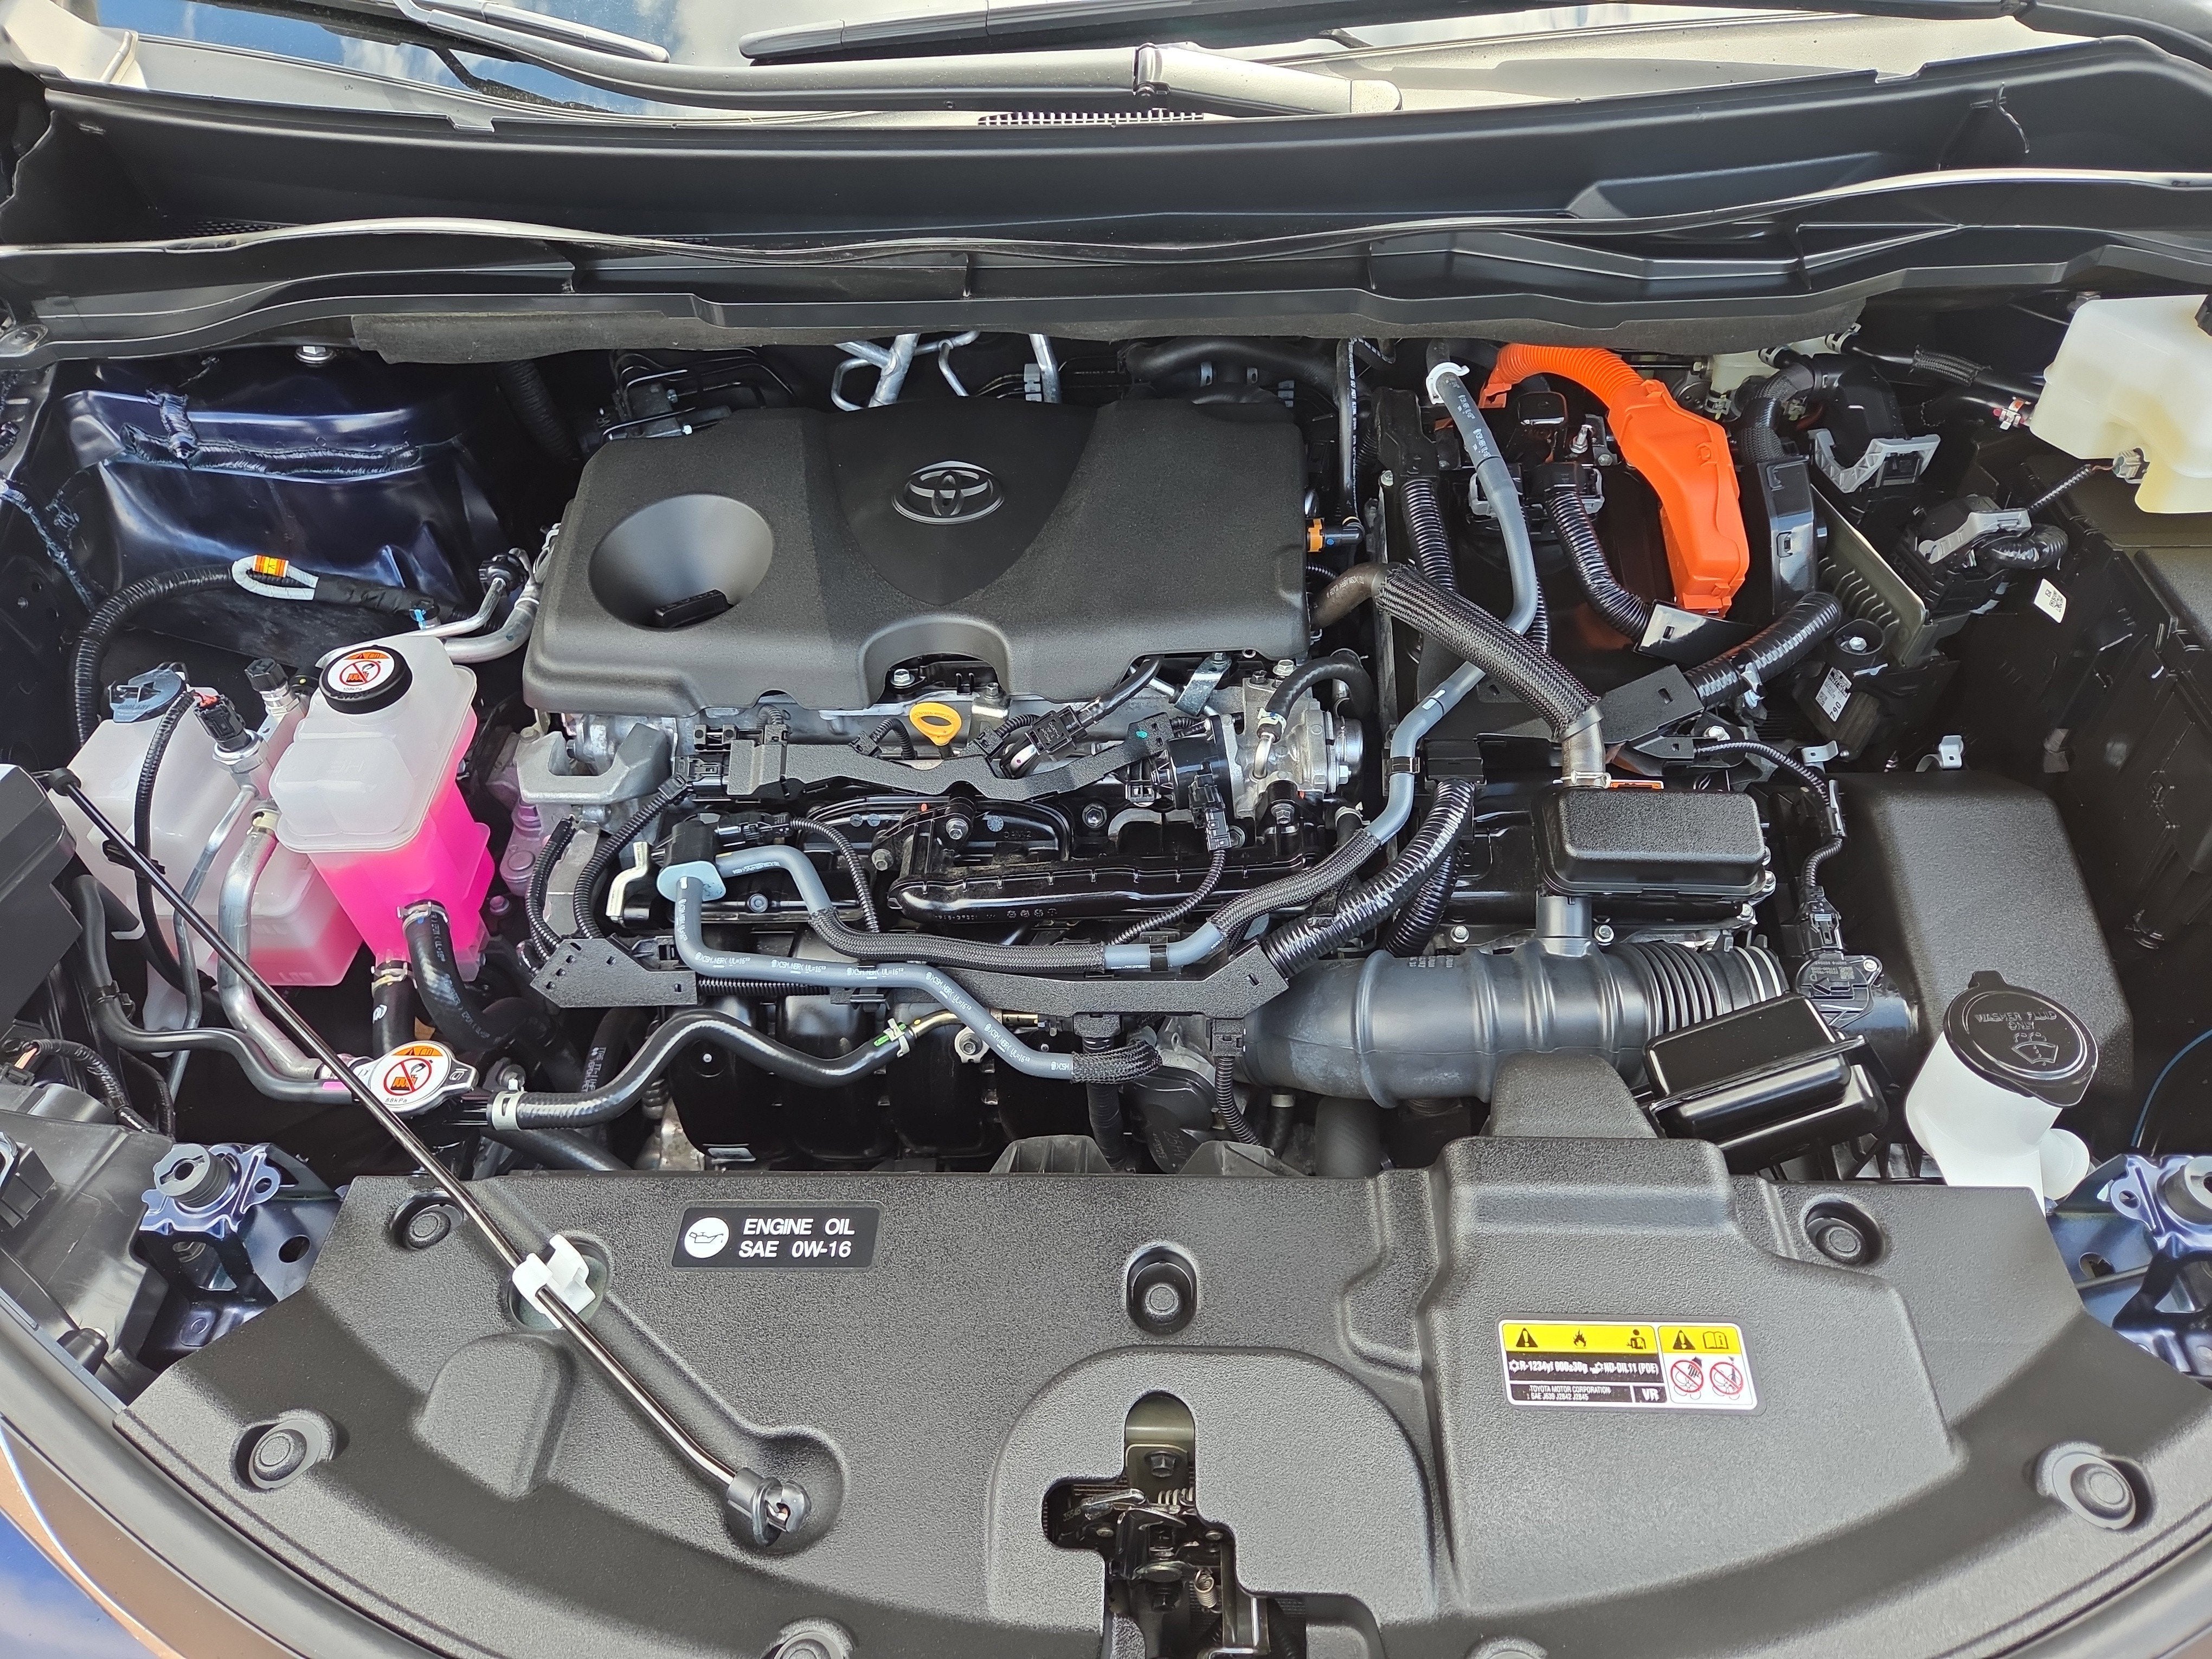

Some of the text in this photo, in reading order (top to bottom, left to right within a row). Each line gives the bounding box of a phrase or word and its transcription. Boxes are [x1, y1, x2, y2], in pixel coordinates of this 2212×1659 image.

[1830, 702, 1842, 719] 790
[1975, 1011, 2057, 1023] WASHER FLUID
[743, 1218, 855, 1236] ENGINE OIL
[738, 1240, 852, 1258] SAE 0W-16
[1519, 1360, 1554, 1374] R-1234yf
[1638, 1362, 1660, 1376] (POE)
[1572, 1386, 1611, 1394] CORPORATION
[1641, 1387, 1660, 1401] VR
